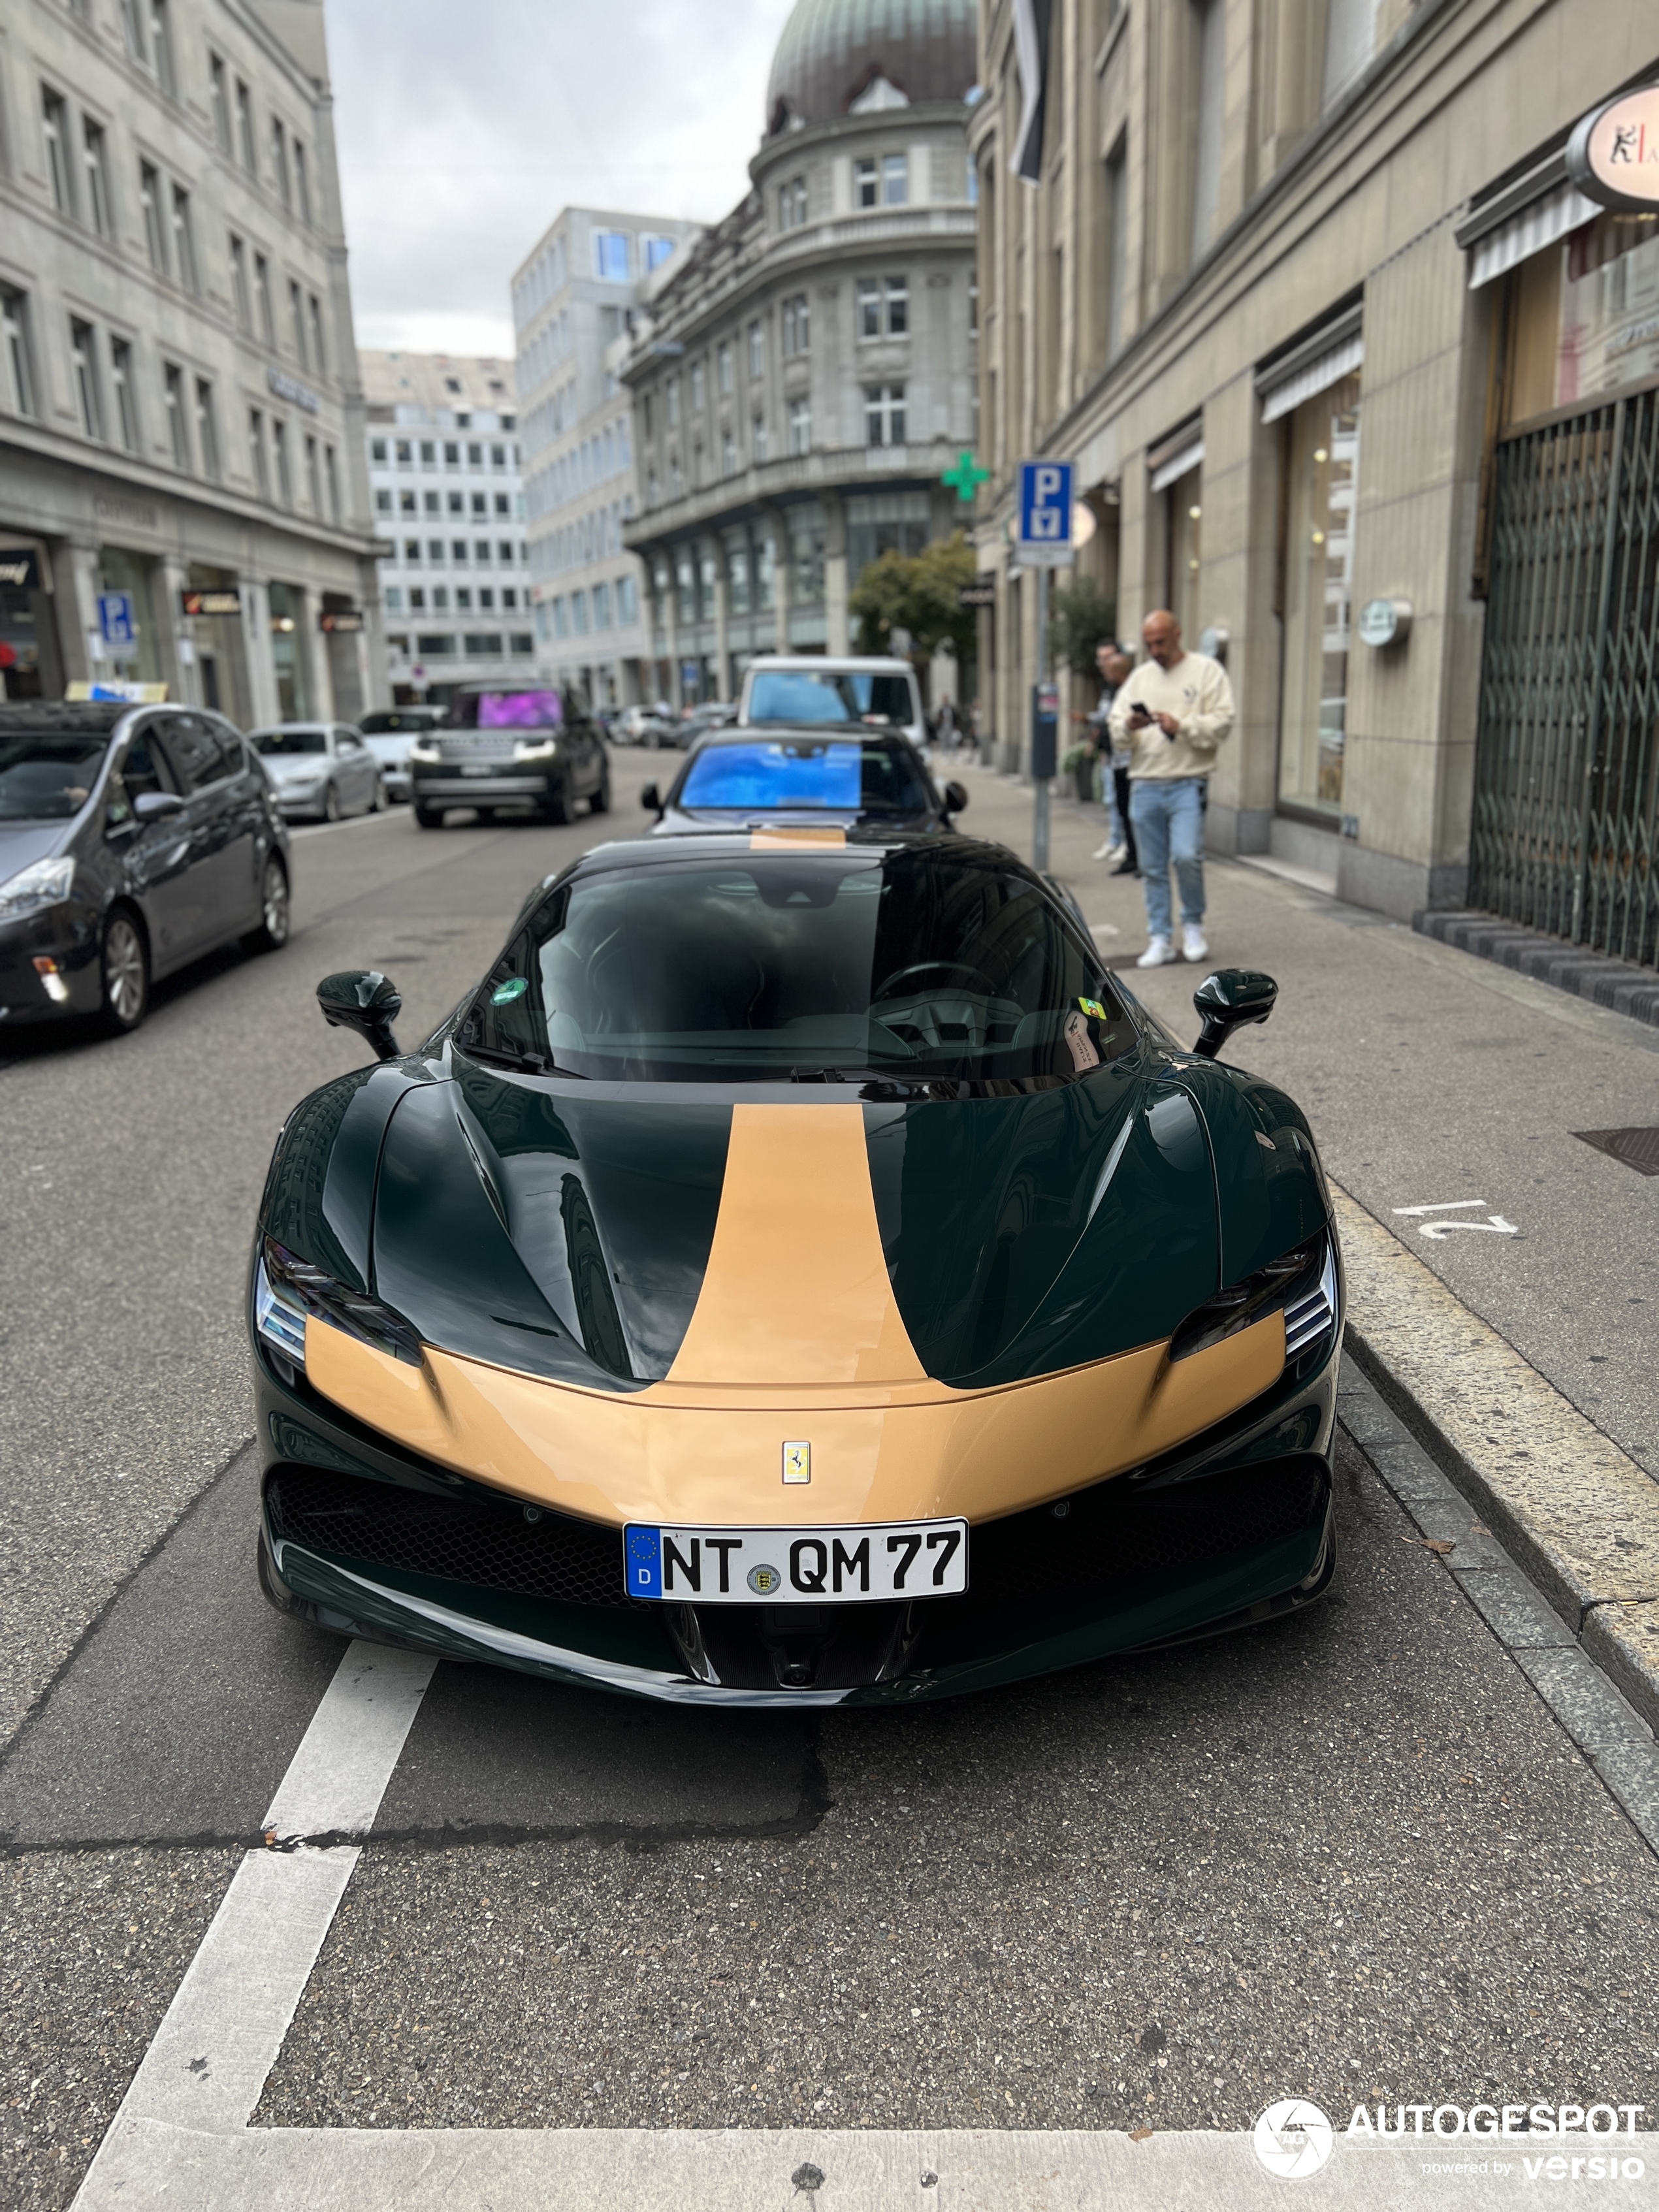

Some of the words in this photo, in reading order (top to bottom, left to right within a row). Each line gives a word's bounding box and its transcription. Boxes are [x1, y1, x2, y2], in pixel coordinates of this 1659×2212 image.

[1035, 468, 1061, 506] P
[639, 1569, 651, 1584] D
[663, 1536, 743, 1592] NT
[789, 1537, 870, 1593] QM
[886, 1530, 961, 1590] 77
